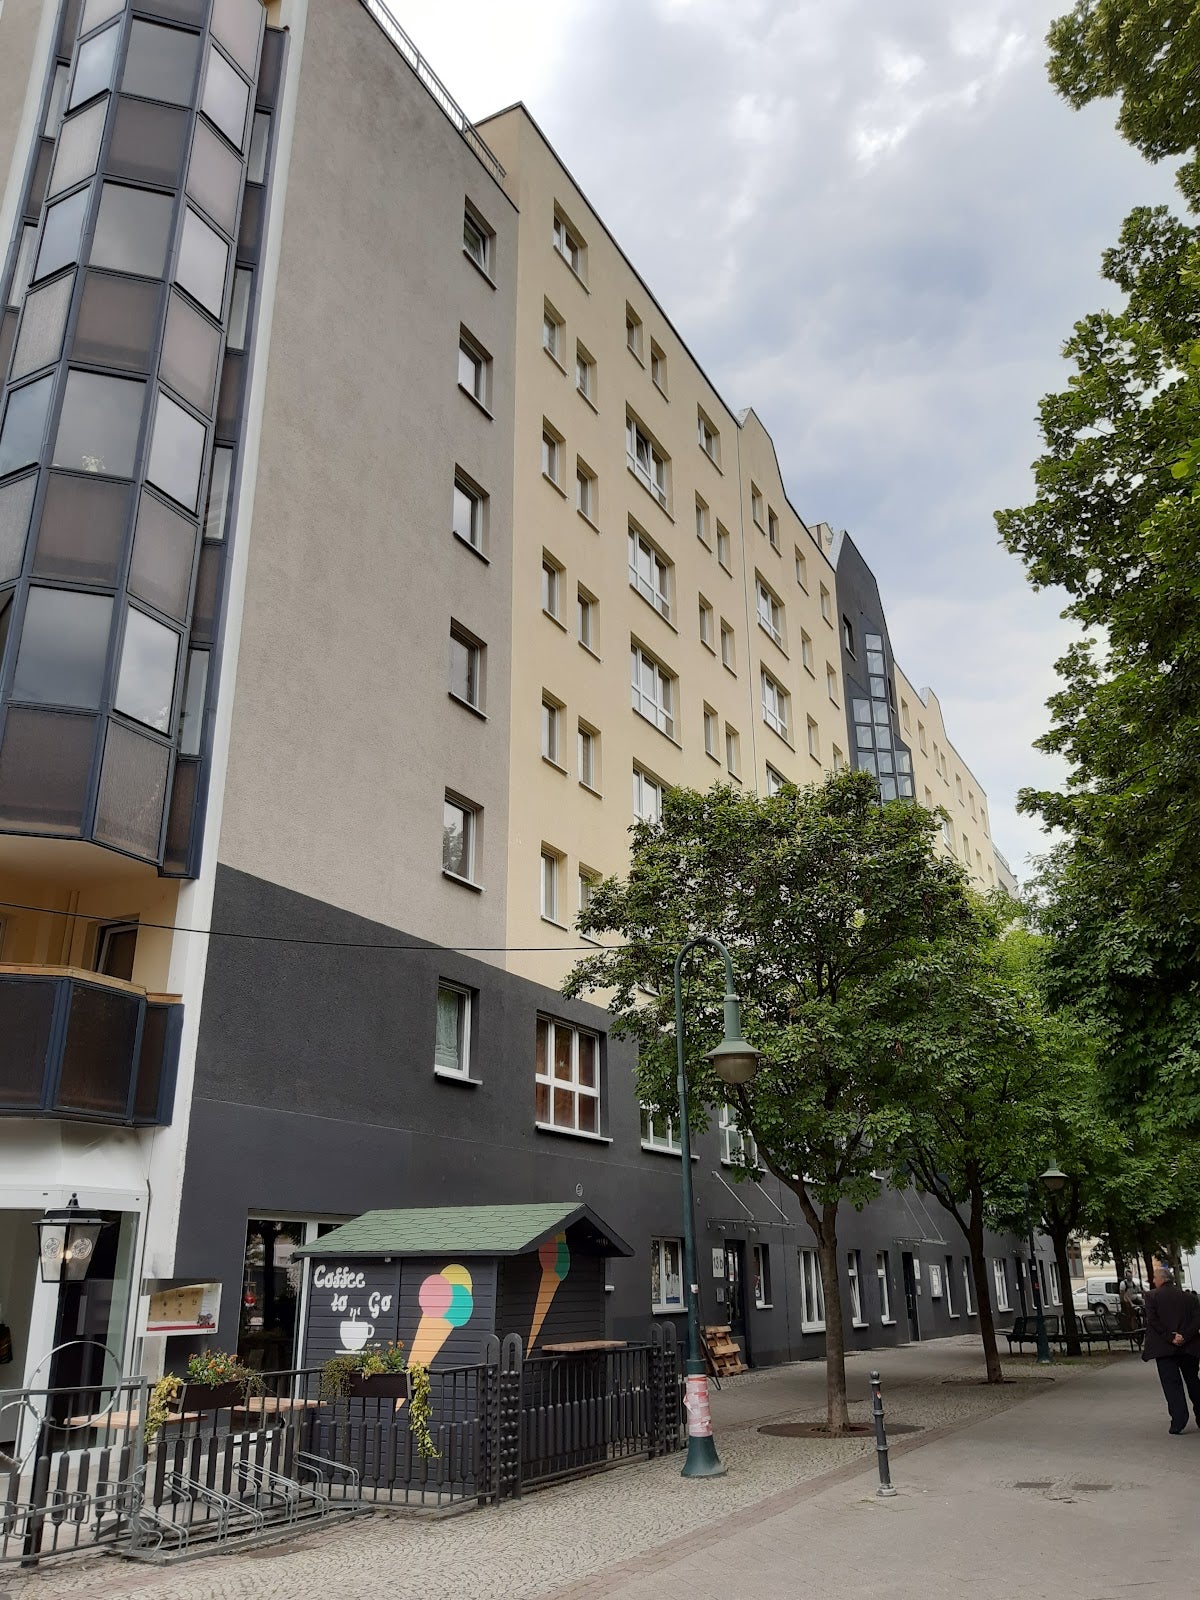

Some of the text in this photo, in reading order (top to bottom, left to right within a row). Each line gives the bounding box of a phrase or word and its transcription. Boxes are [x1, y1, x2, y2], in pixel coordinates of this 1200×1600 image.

[313, 1264, 366, 1288] Coffee
[330, 1291, 393, 1319] to Go
